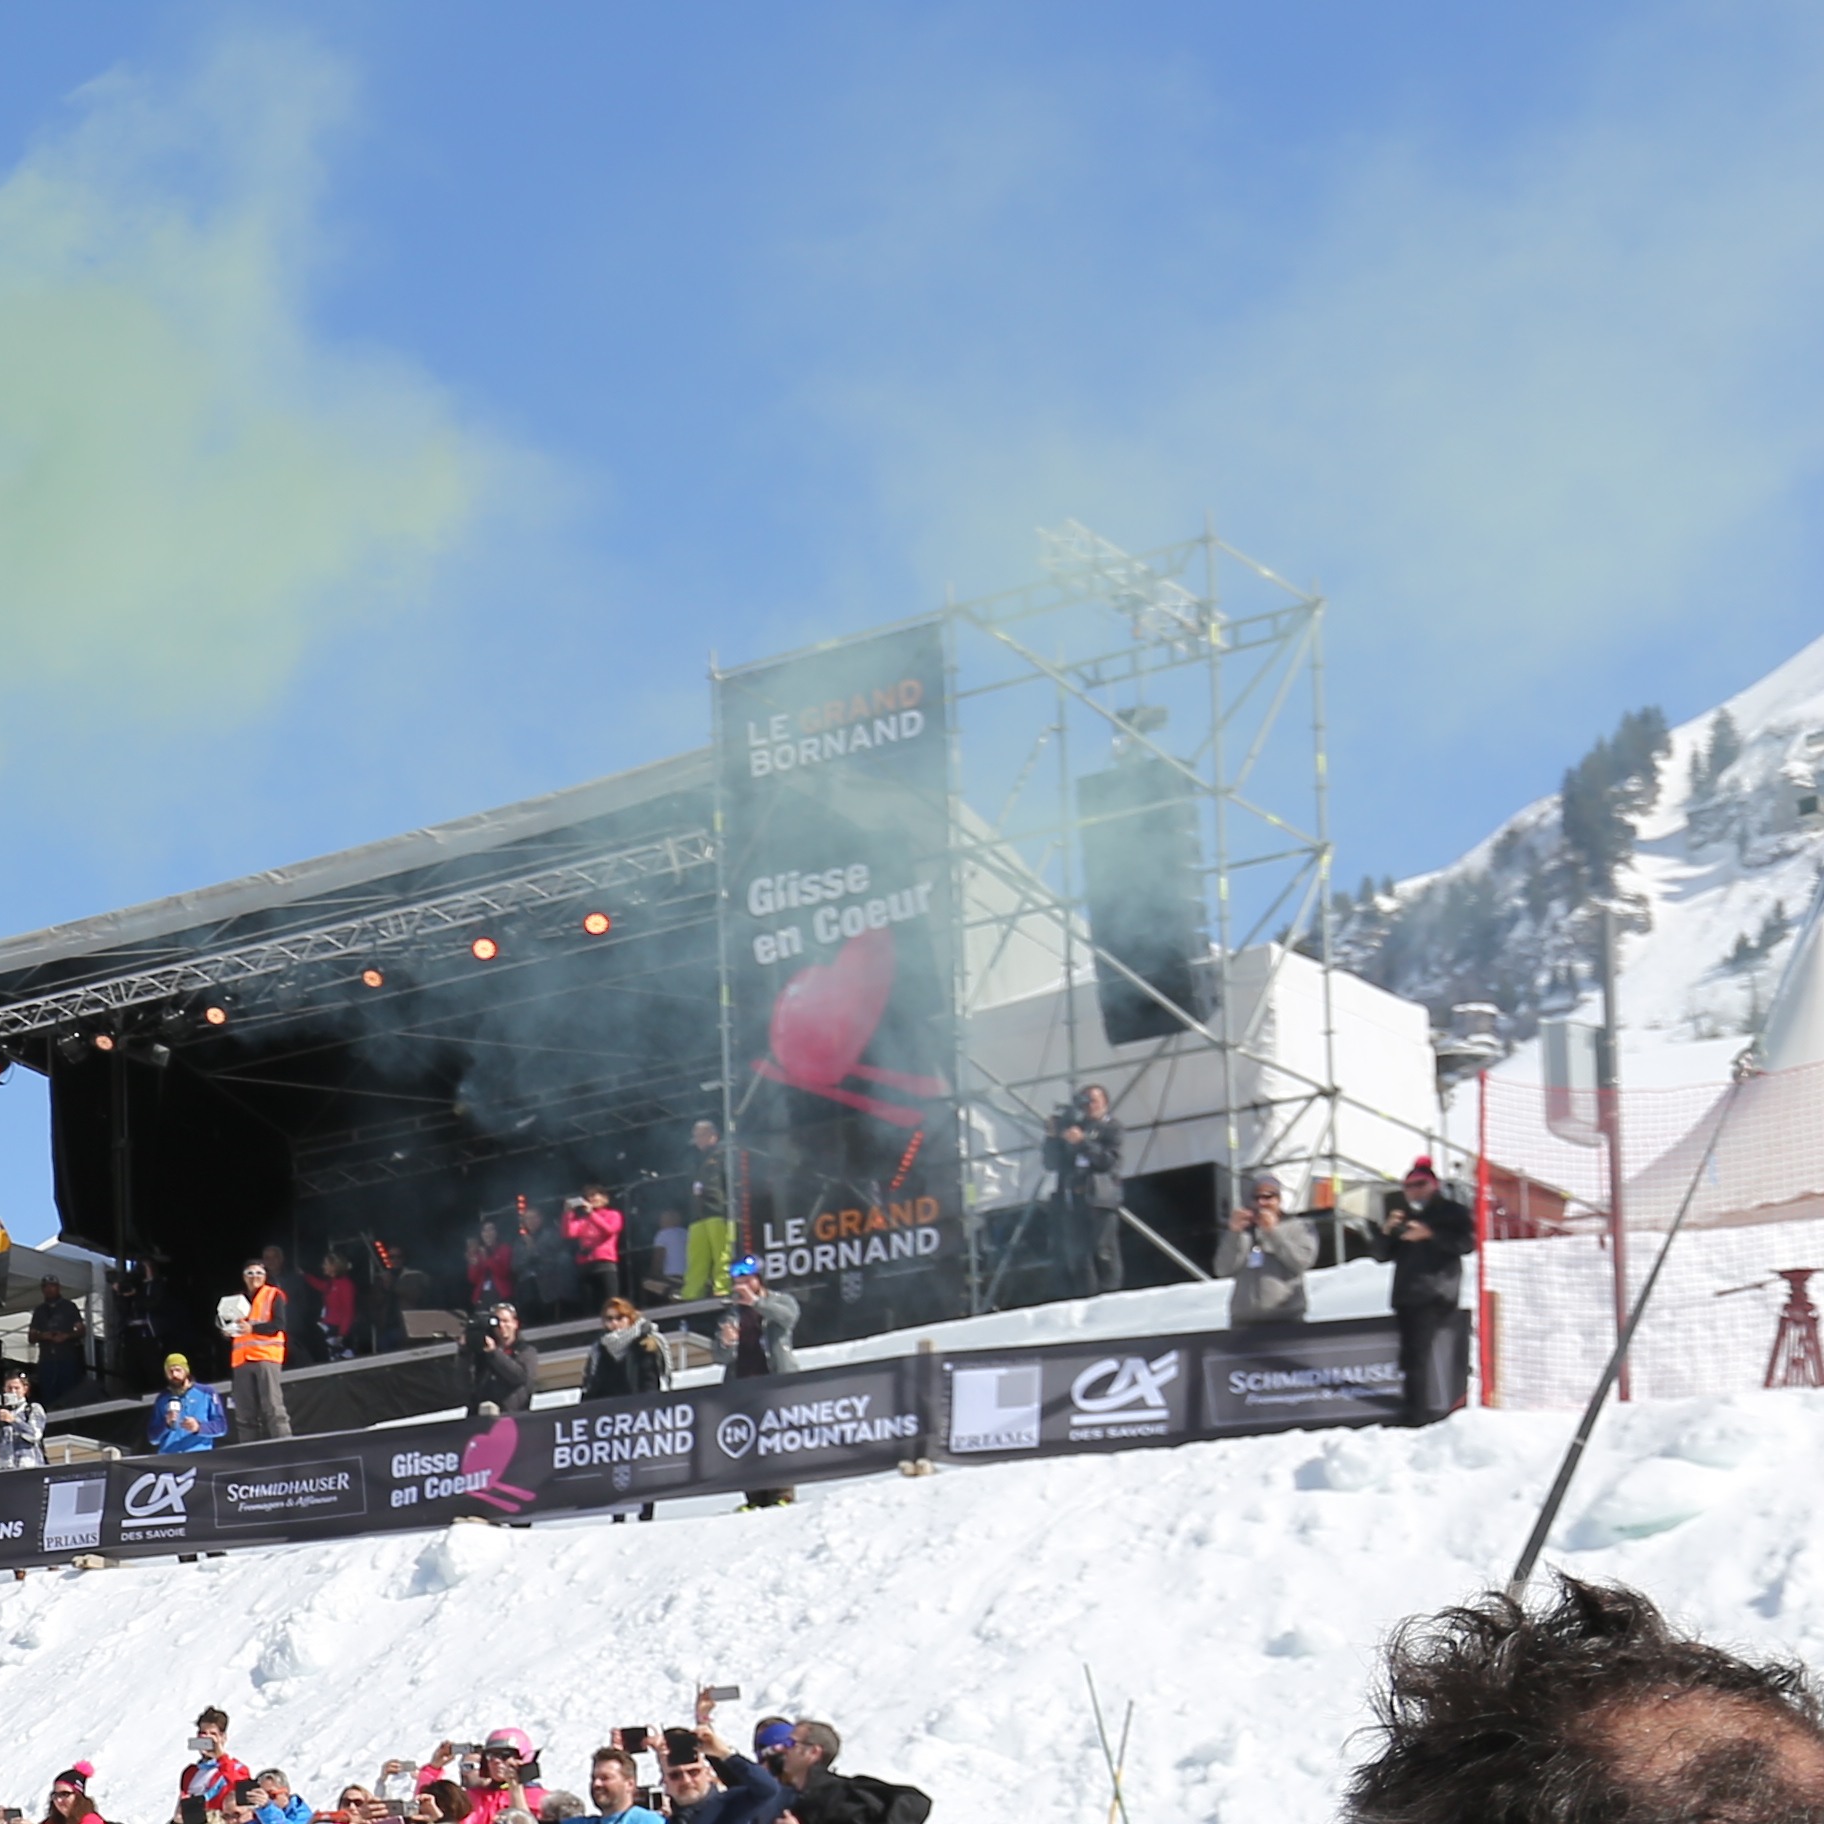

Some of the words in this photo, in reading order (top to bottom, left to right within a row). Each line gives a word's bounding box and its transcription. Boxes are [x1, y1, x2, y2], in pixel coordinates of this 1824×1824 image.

[747, 713, 791, 749] LE
[799, 679, 924, 735] GRAND
[750, 709, 925, 778] BORNAND
[747, 863, 871, 917] Glisse
[753, 925, 803, 965] en
[812, 879, 933, 945] Coeur
[763, 1217, 807, 1250] LE
[814, 1195, 940, 1241] GRAND
[764, 1226, 941, 1280] BORNAND
[554, 1420, 587, 1445] LE
[595, 1404, 694, 1438] GRAND
[759, 1395, 871, 1432] ANNECY
[1069, 1426, 1102, 1441] DES
[553, 1430, 695, 1469] BORNAND
[756, 1413, 920, 1457] MOUNTAINS
[391, 1451, 459, 1478] Glisse
[226, 1472, 351, 1502] SCHMIDHAUSER
[390, 1487, 418, 1508] en
[424, 1469, 493, 1501] Coeur
[45, 1531, 99, 1548] PRIAMS
[120, 1530, 139, 1542] DES
[143, 1527, 186, 1540] SAVOIE
